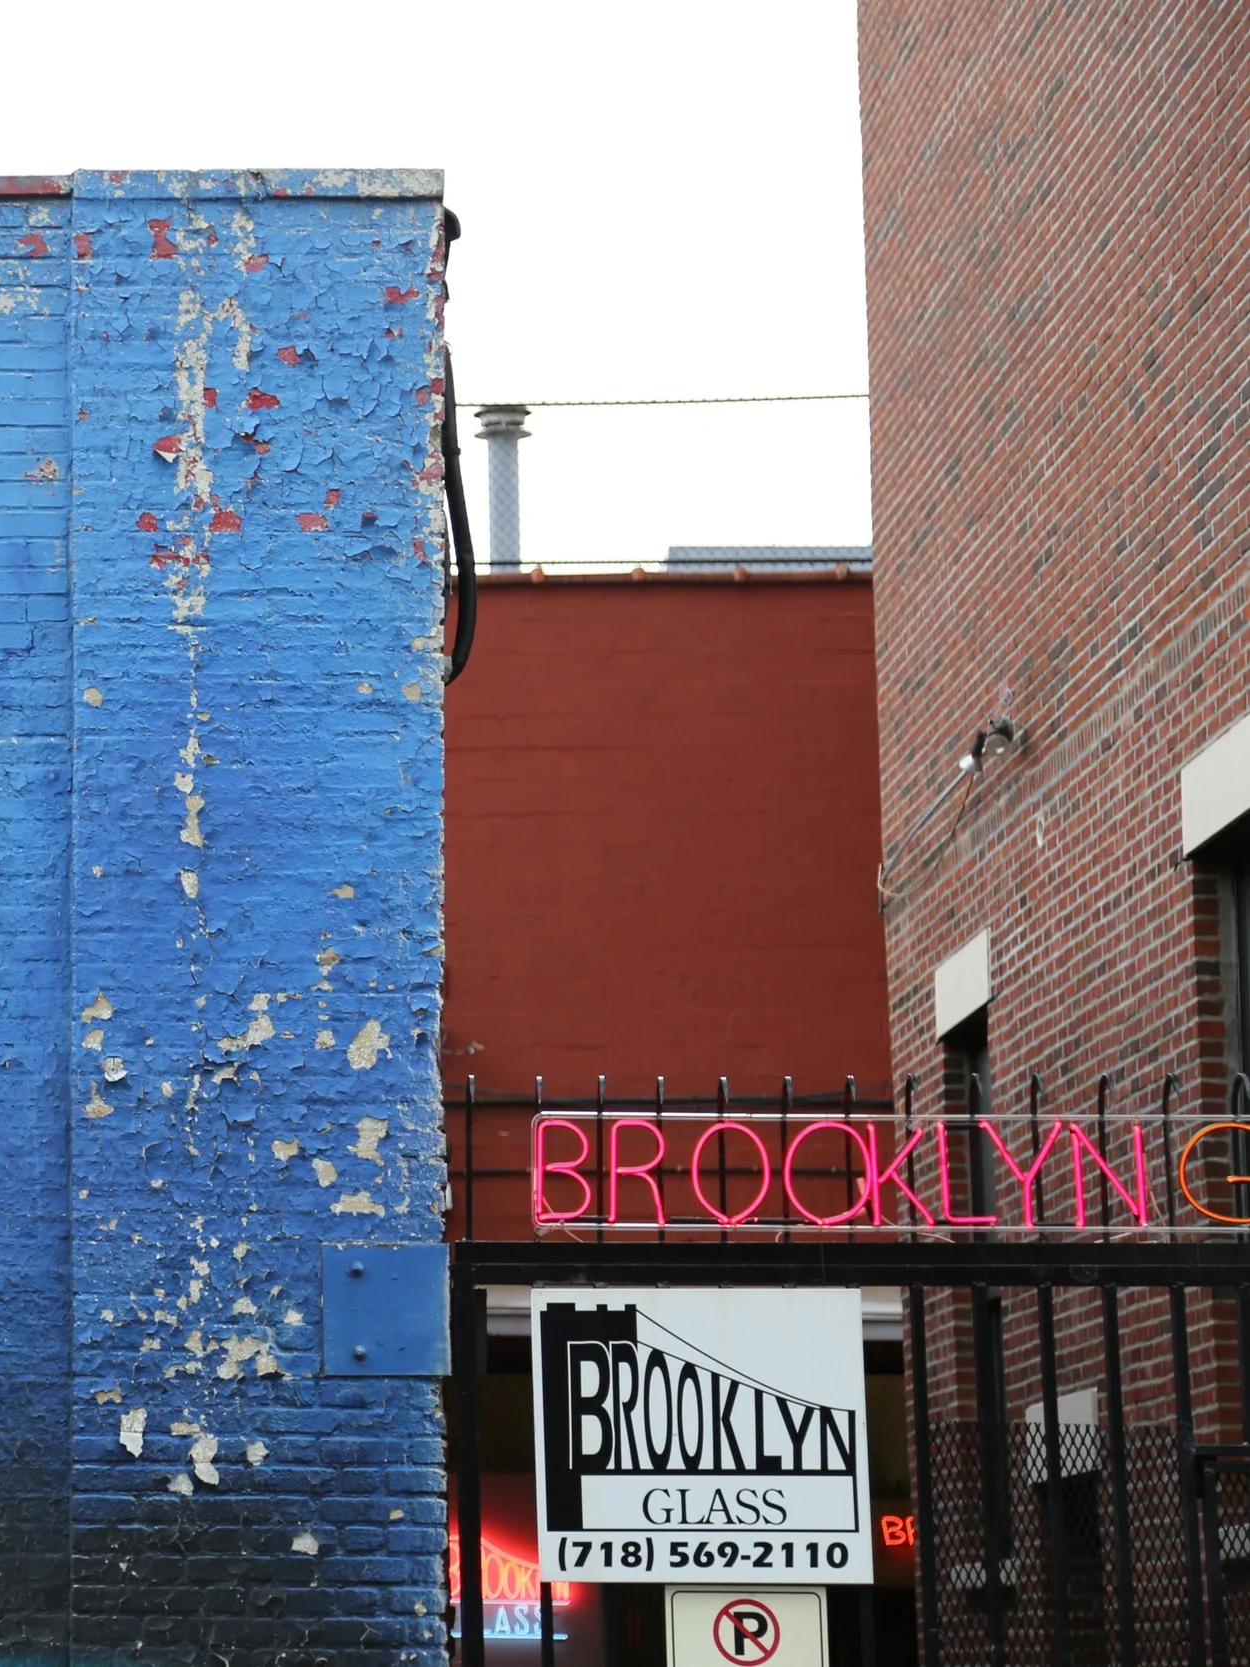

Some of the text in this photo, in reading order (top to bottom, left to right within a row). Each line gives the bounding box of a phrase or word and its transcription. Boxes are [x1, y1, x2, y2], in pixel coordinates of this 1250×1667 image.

[536, 1119, 1148, 1227] BROOKLYN
[567, 1341, 856, 1471] BROOKLYN
[642, 1488, 787, 1525] GLASS
[558, 1537, 849, 1571] (718) 569-2110
